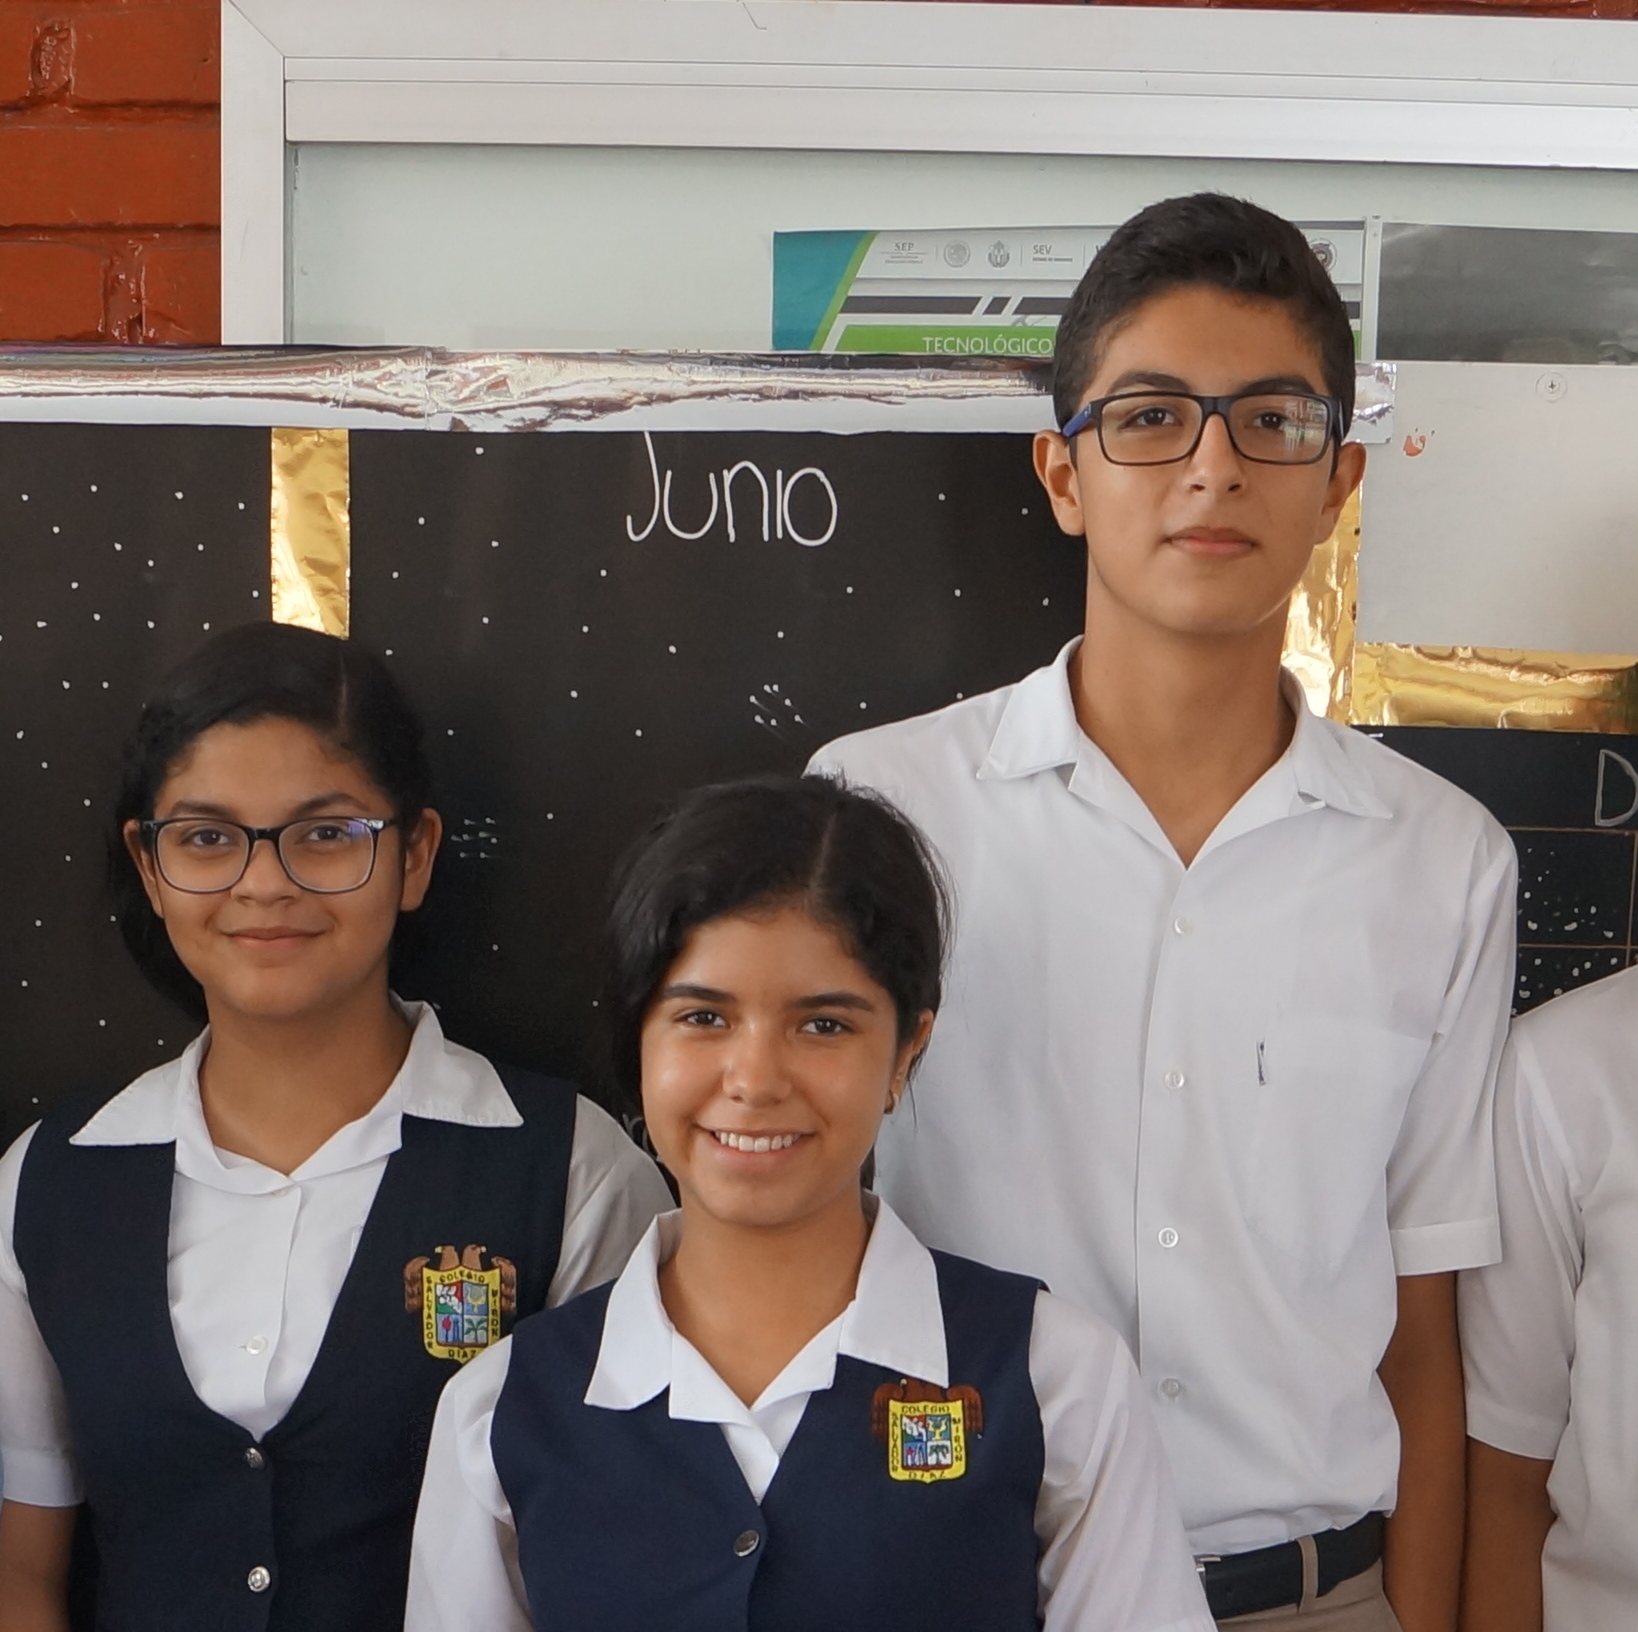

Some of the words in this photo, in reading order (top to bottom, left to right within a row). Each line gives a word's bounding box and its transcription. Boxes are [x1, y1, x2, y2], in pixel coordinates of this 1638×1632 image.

[894, 242, 914, 252] SEP
[1032, 244, 1052, 255] SEV
[922, 333, 1053, 354] TECNOLÓGICO
